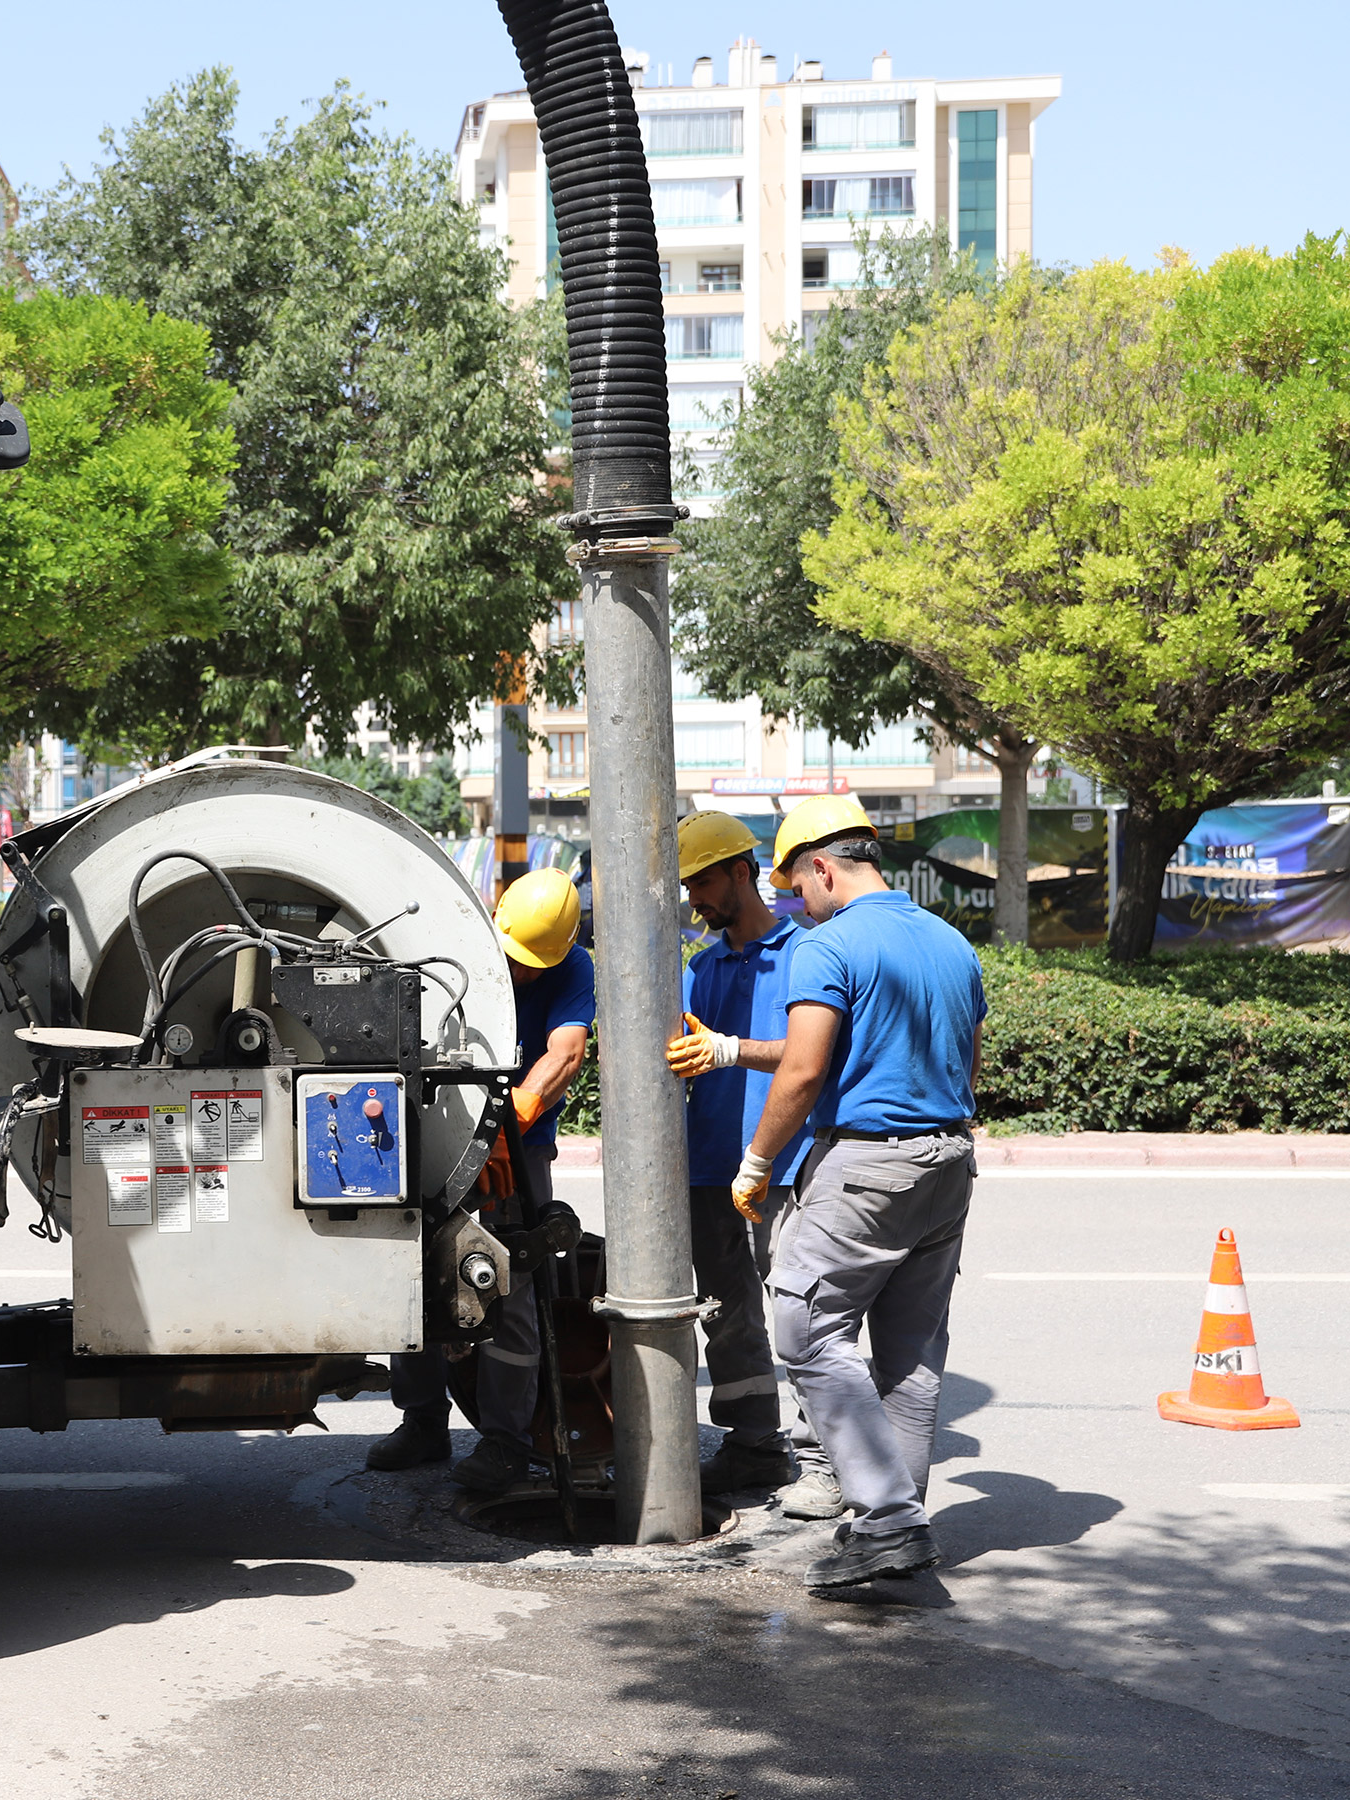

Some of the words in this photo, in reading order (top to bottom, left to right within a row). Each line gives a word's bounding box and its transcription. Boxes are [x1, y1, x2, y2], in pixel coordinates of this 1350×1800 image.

[786, 778, 845, 791] MARKT
[102, 1108, 135, 1118] DİKKAT
[1194, 1350, 1244, 1373] SKİ
